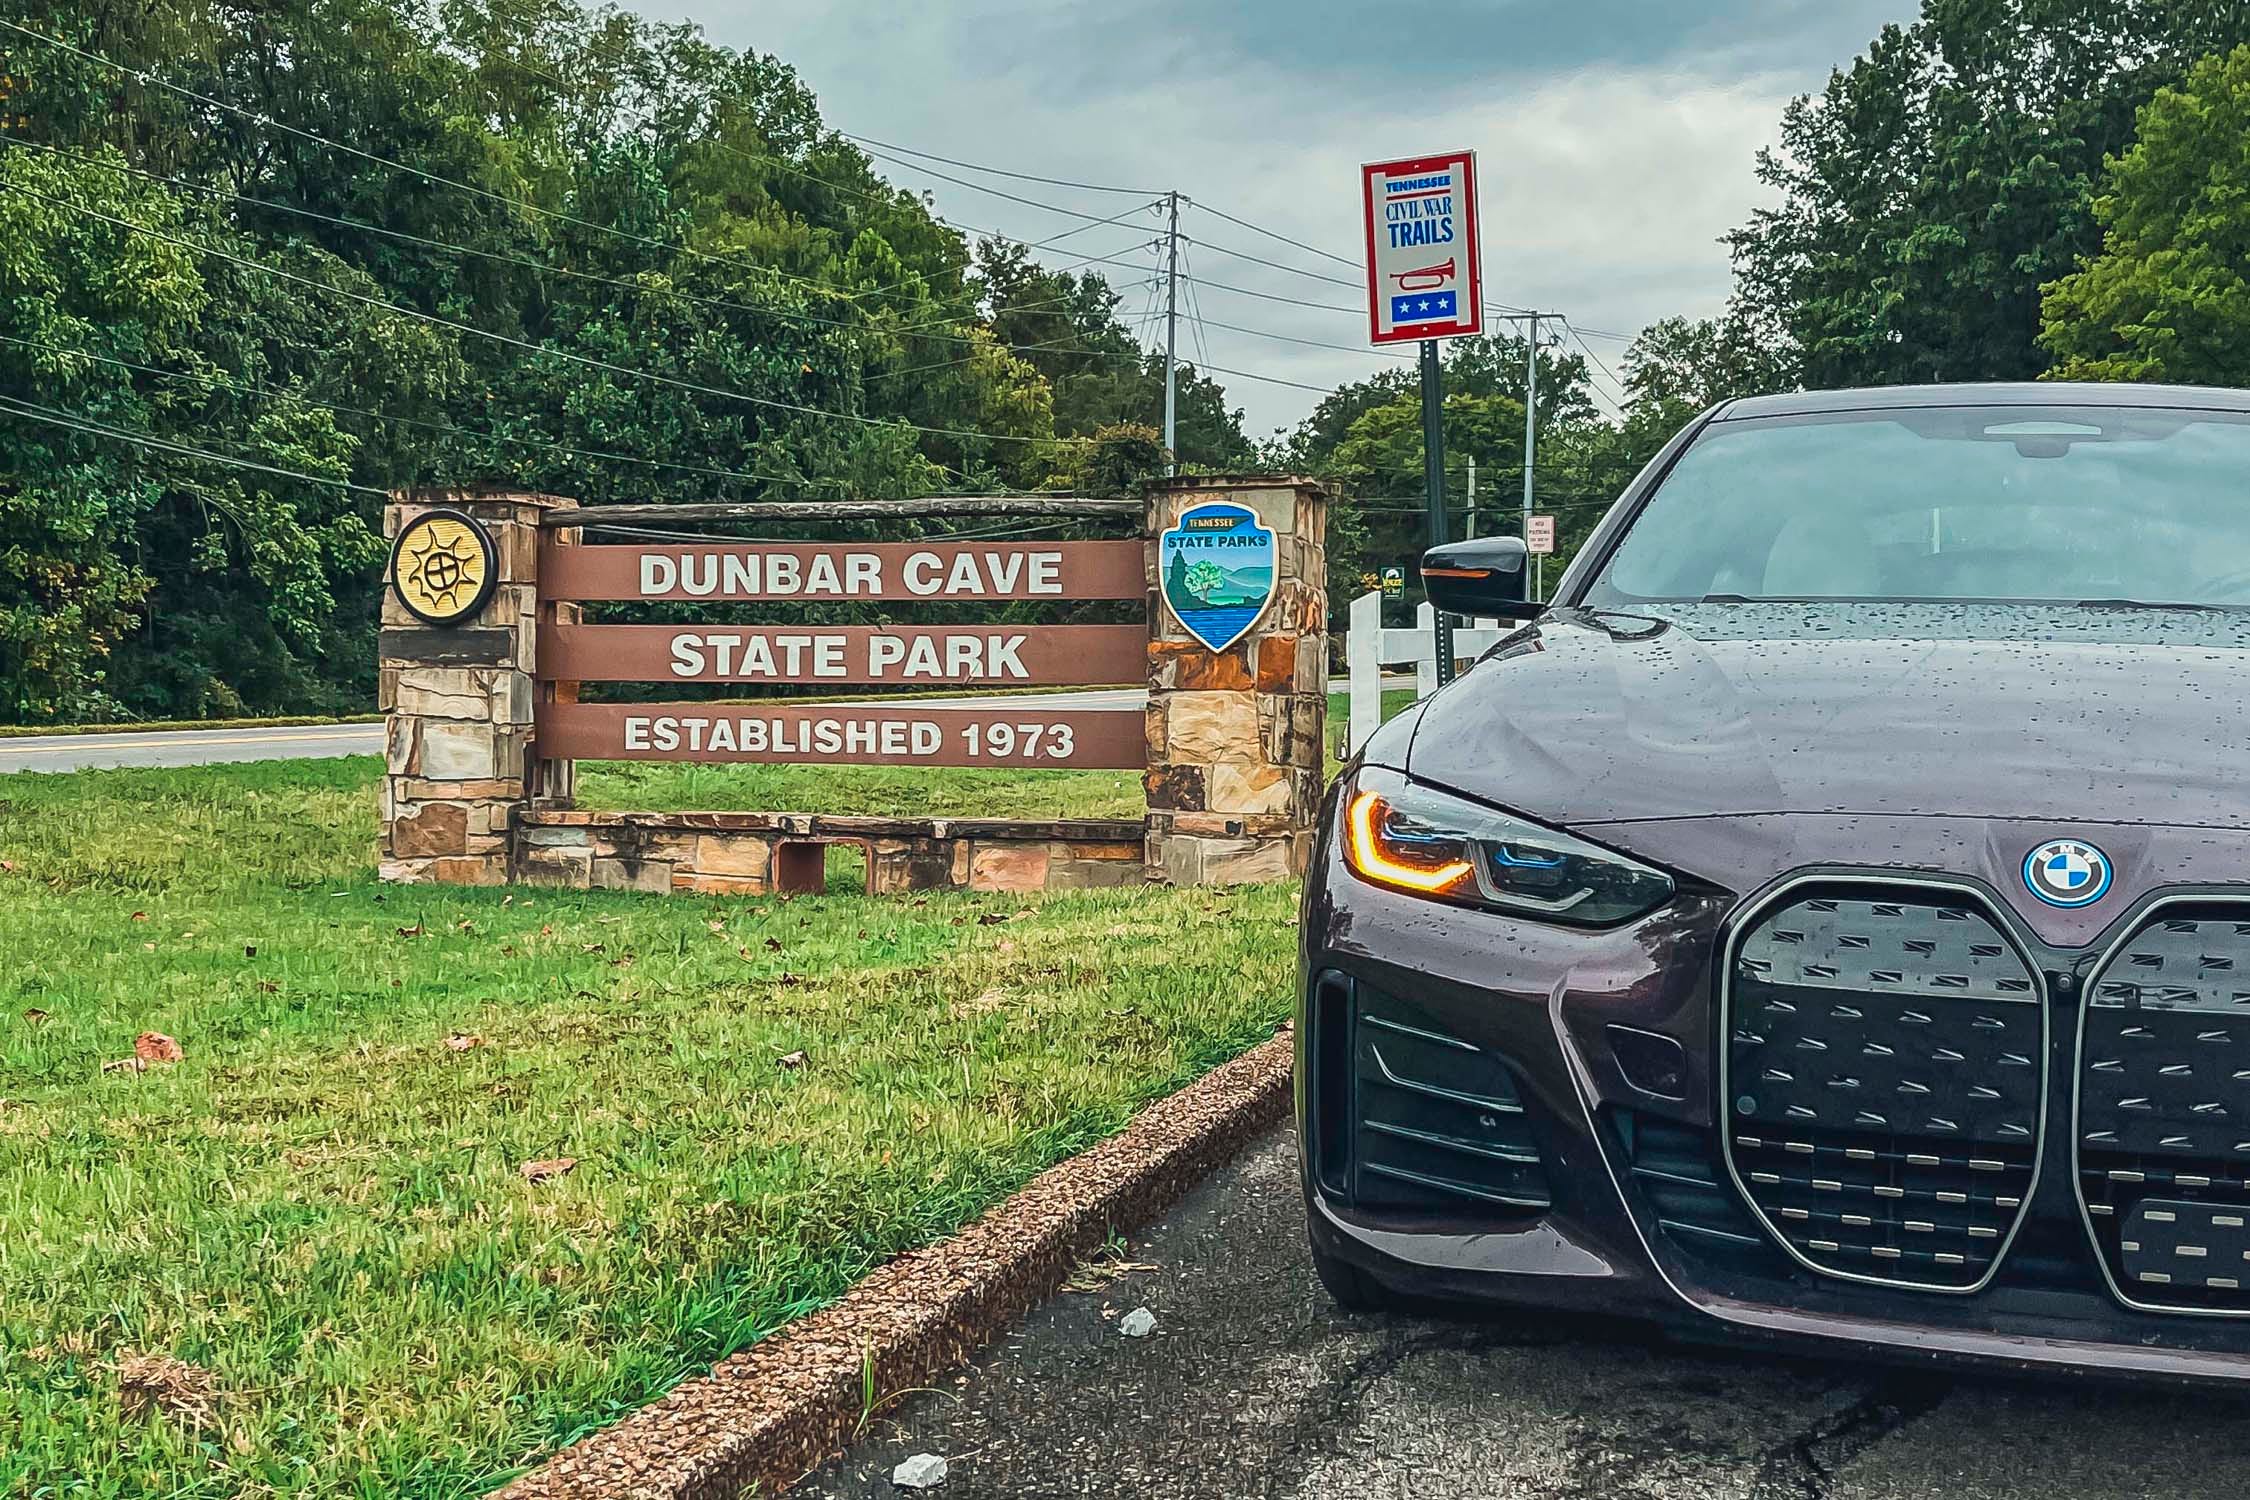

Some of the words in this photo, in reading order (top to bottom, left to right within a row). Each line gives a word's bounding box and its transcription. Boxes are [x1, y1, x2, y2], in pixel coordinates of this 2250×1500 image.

[1386, 175, 1451, 193] TENNESSEE
[1386, 199, 1423, 222] CIVIL
[1424, 196, 1452, 216] WAR
[1388, 217, 1455, 249] TRAILS
[1189, 518, 1235, 528] TENNESSEE
[1167, 536, 1213, 549] STATE
[1217, 535, 1268, 548] PARKS
[639, 552, 884, 596] DUNBAR
[902, 551, 1064, 596] CAVE
[669, 633, 848, 679] STATE
[868, 634, 1030, 679] PARK
[624, 716, 943, 756] ESTABLISHED
[960, 722, 1075, 759] 1973
[2038, 844, 2099, 864] BMW
